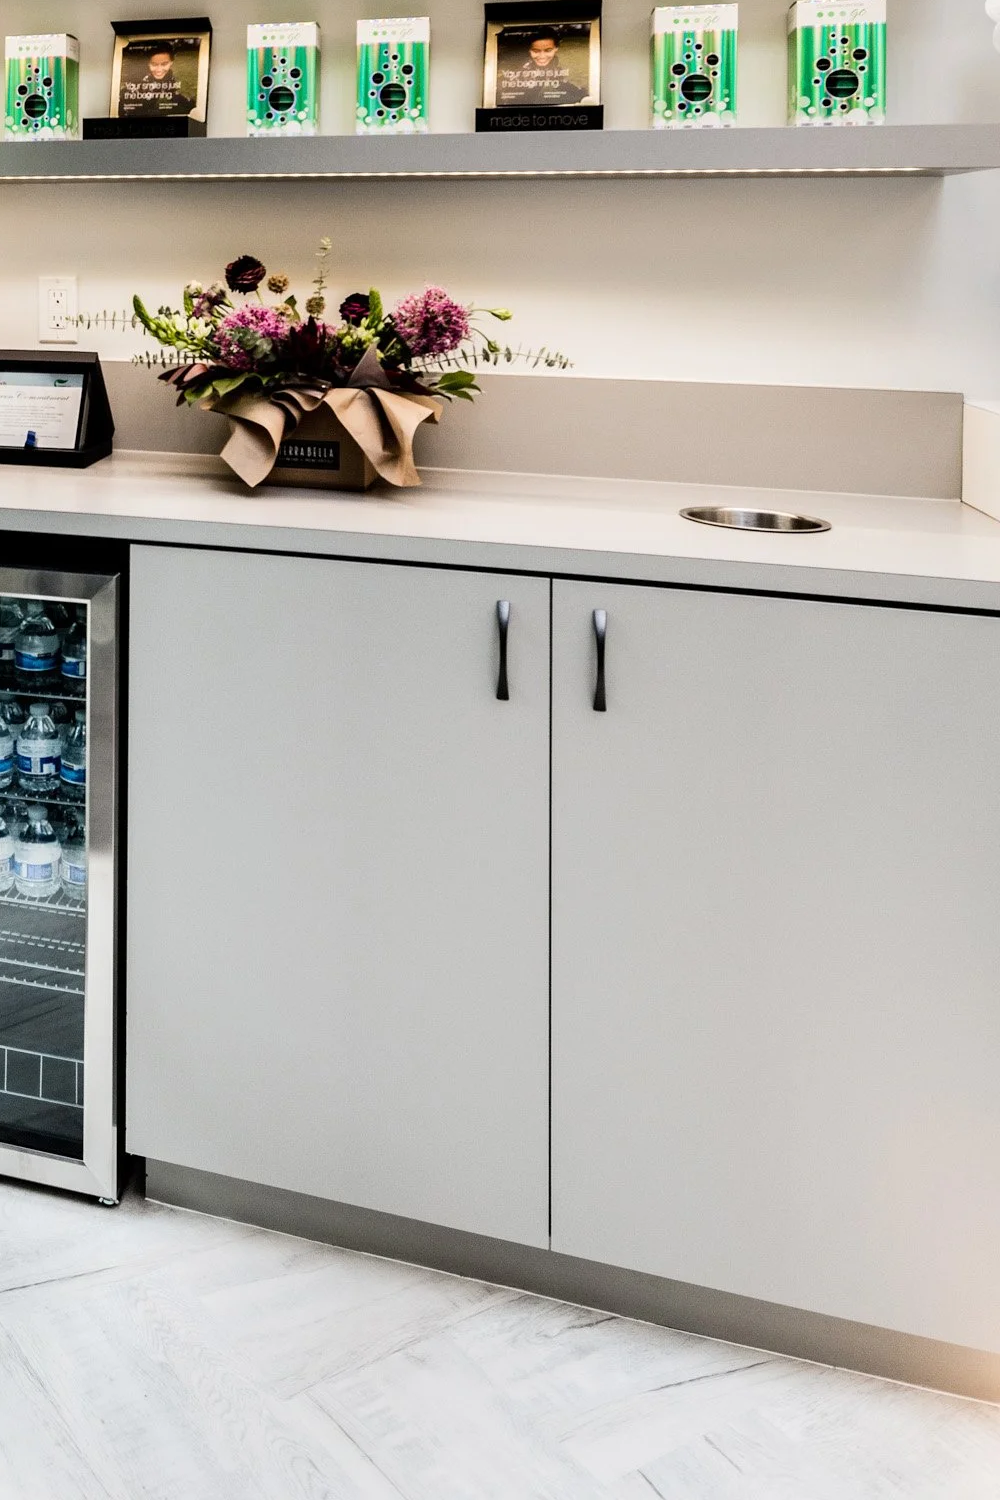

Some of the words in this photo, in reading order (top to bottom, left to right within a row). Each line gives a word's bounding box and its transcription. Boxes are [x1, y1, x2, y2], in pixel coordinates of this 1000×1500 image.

[522, 69, 545, 78] smile
[546, 69, 554, 77] is
[553, 69, 569, 77] just
[142, 81, 161, 90] smile
[161, 81, 168, 89] is
[168, 81, 181, 90] just
[490, 113, 530, 126] made
[532, 113, 546, 126] to
[548, 114, 588, 126] move
